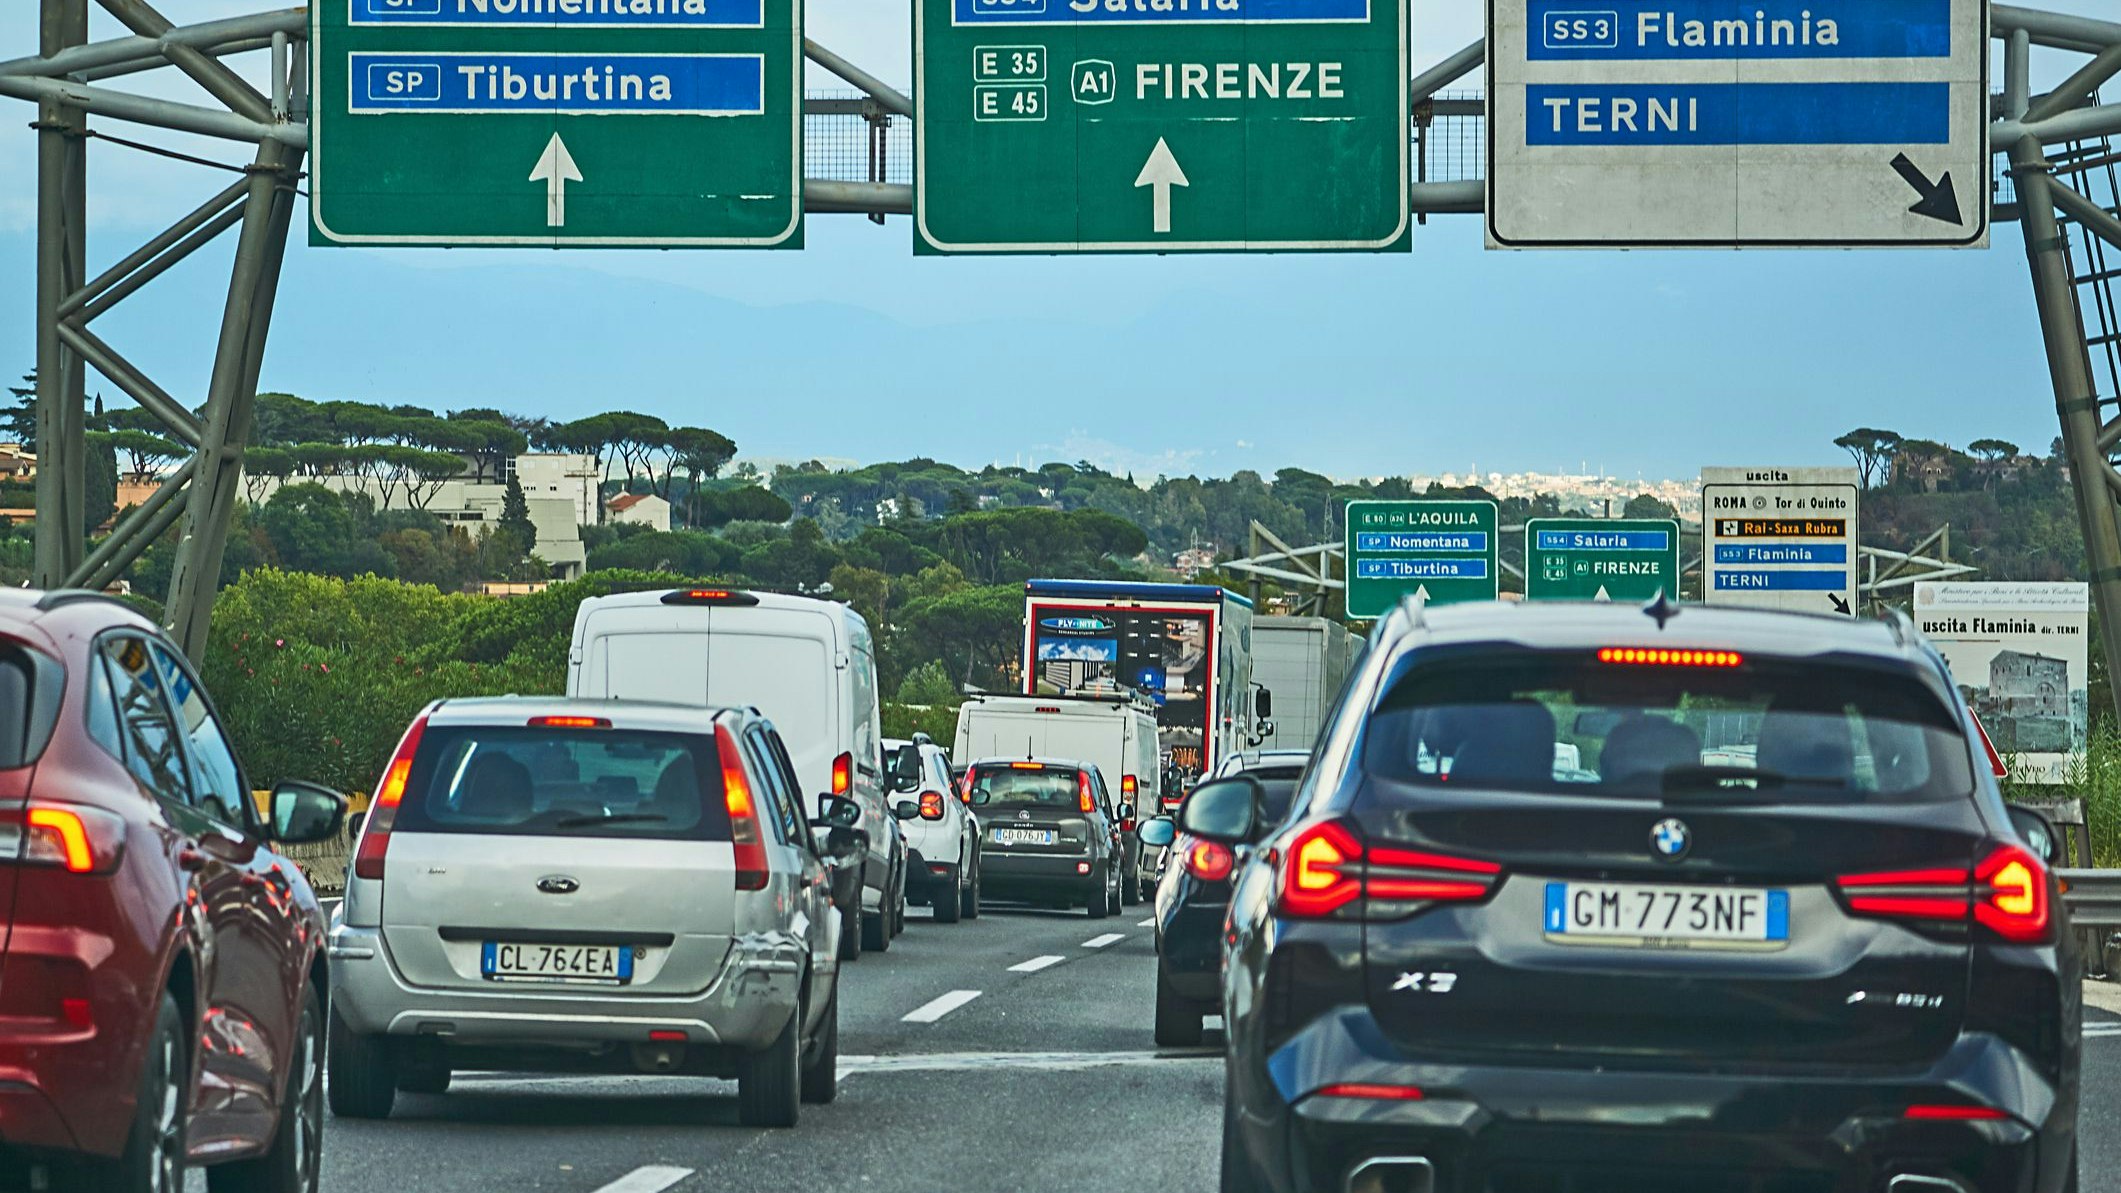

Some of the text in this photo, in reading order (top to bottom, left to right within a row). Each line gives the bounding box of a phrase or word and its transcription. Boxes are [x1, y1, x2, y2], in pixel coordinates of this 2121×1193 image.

[1637, 9, 1840, 47] Flaminia
[982, 52, 1038, 75] E 35
[386, 64, 672, 101] SP Tiburtina
[1079, 61, 1344, 100] A1 FIRENZE
[983, 91, 1038, 115] E 45
[1543, 97, 1697, 132] TERNI
[1746, 470, 1788, 482] uscita
[1714, 497, 1846, 509] ROMA Tor di Quinto
[1408, 512, 1479, 525] L'AQUILA
[1805, 522, 1838, 534] Rubra
[1368, 536, 1470, 548] SP Nomentana
[1574, 534, 1628, 547] Salaria
[1748, 547, 1812, 560] Flaminia
[1368, 562, 1459, 575] SP Tiburtina
[1576, 561, 1660, 574] A1 FIRENZE
[1719, 574, 1769, 587] TERNI
[1923, 617, 2079, 635] uscita Flaminia dir. TERNI
[1574, 890, 1620, 928] GM
[1637, 891, 1759, 932] 773NF
[500, 945, 528, 971] CL
[539, 947, 613, 973] 764EA
[1391, 971, 1458, 993] X3
